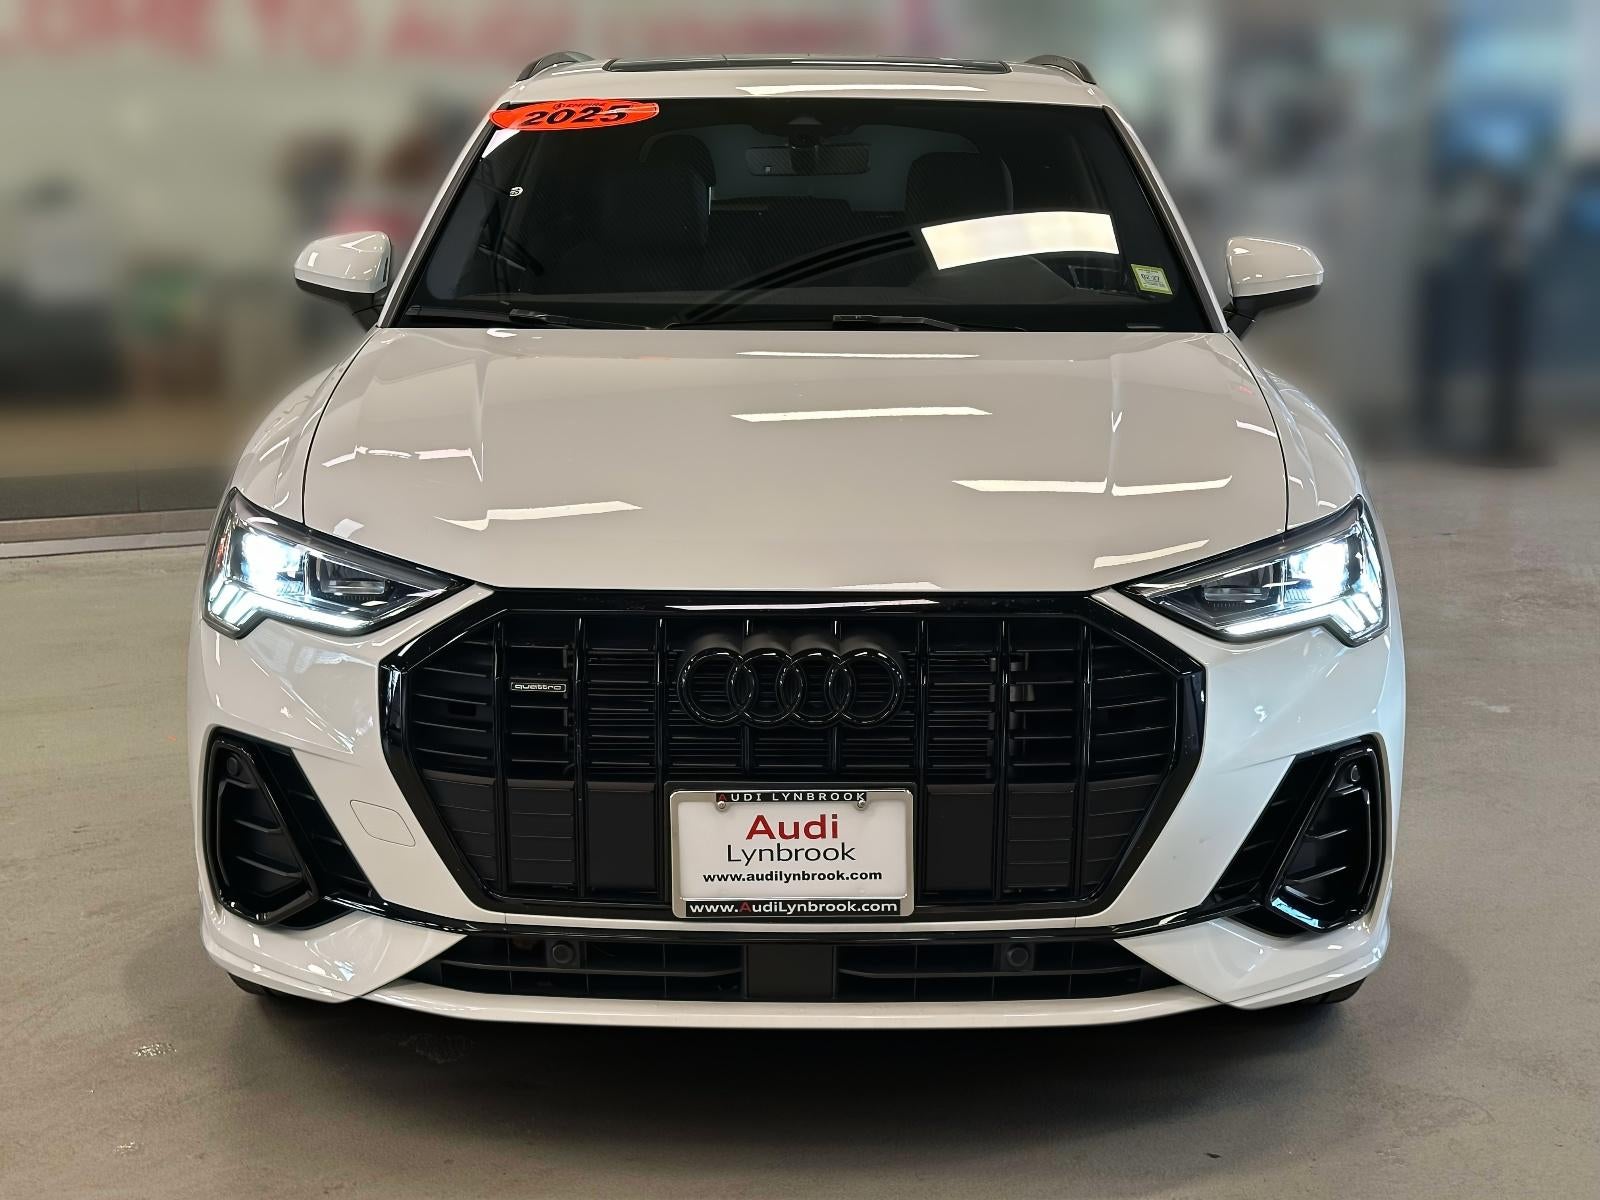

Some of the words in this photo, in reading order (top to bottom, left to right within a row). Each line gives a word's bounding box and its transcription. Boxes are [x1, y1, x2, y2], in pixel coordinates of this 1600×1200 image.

[520, 105, 631, 125] 2025
[717, 792, 762, 802] AUDI
[772, 792, 866, 802] LYNBROOK
[745, 814, 839, 840] Audi
[727, 842, 856, 866] Lynbrook
[702, 870, 883, 884] www.audilynbrook.com
[689, 900, 898, 915] www.AudiLynbrook.com
